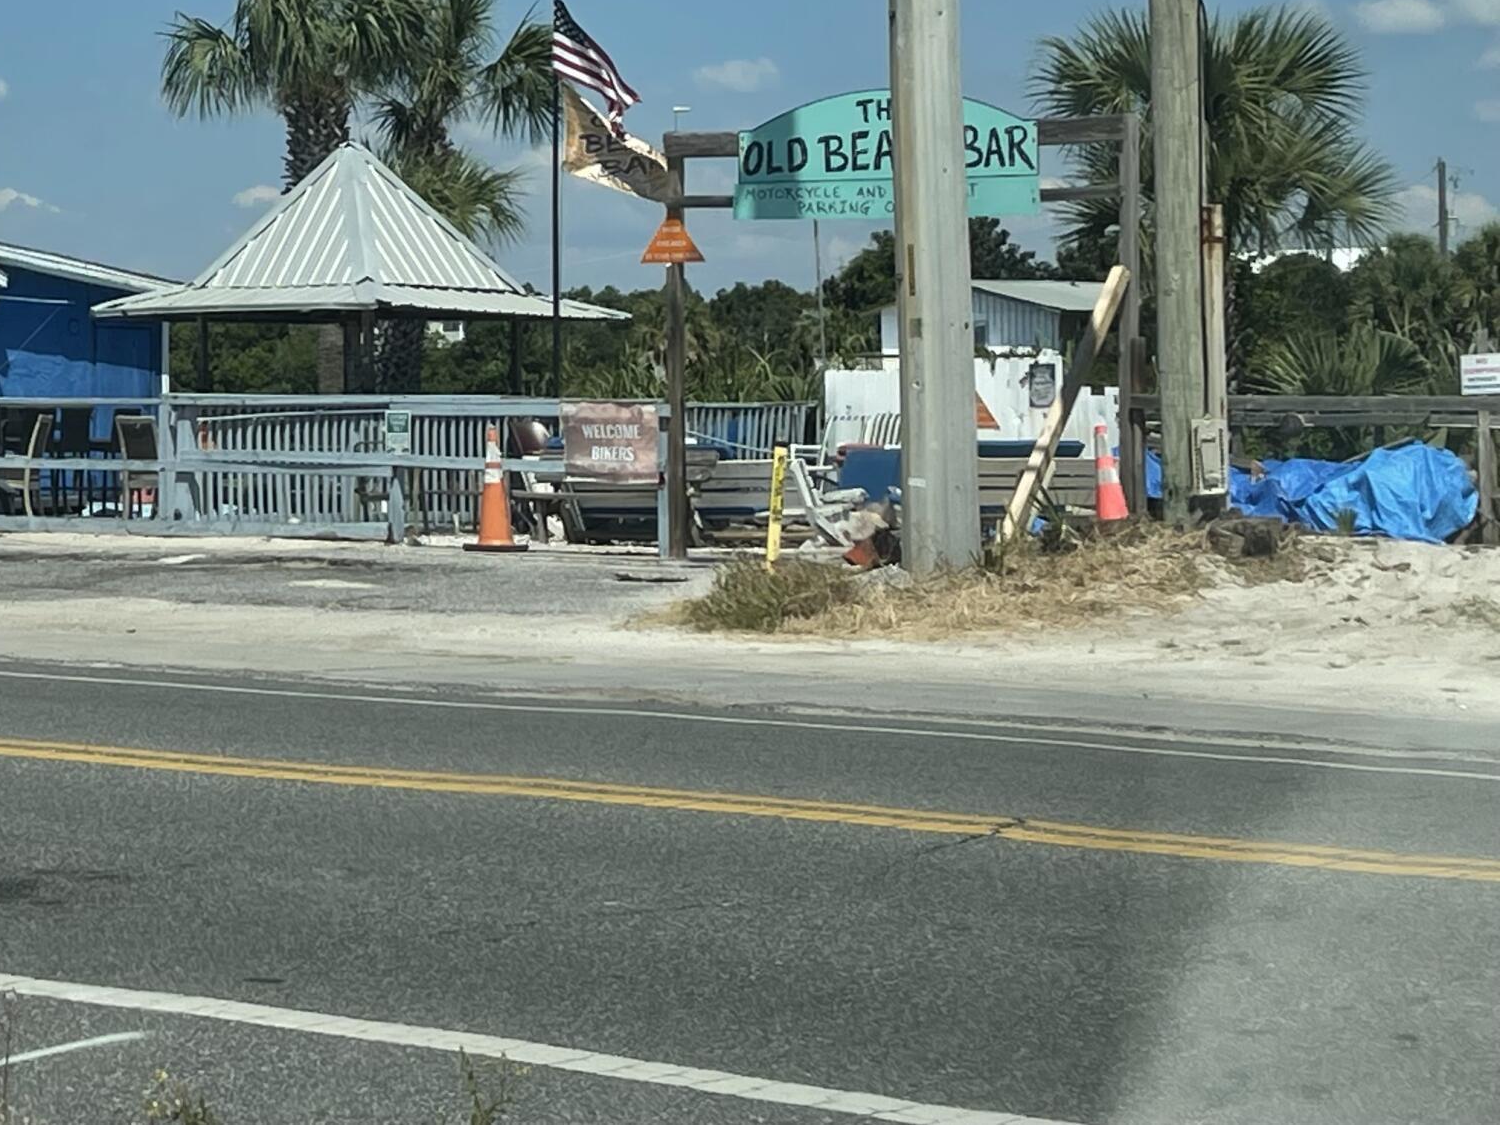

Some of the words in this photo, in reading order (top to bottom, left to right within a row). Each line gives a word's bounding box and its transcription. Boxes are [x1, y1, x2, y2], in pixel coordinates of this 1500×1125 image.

[856, 98, 892, 123] TH
[743, 137, 808, 175] OLD
[817, 130, 893, 172] BEA
[744, 186, 841, 200] MOTORCYCLE
[856, 185, 886, 198] AND
[798, 200, 871, 215] PARKING
[582, 424, 641, 439] WELCOME
[591, 446, 635, 461] BIKERS
